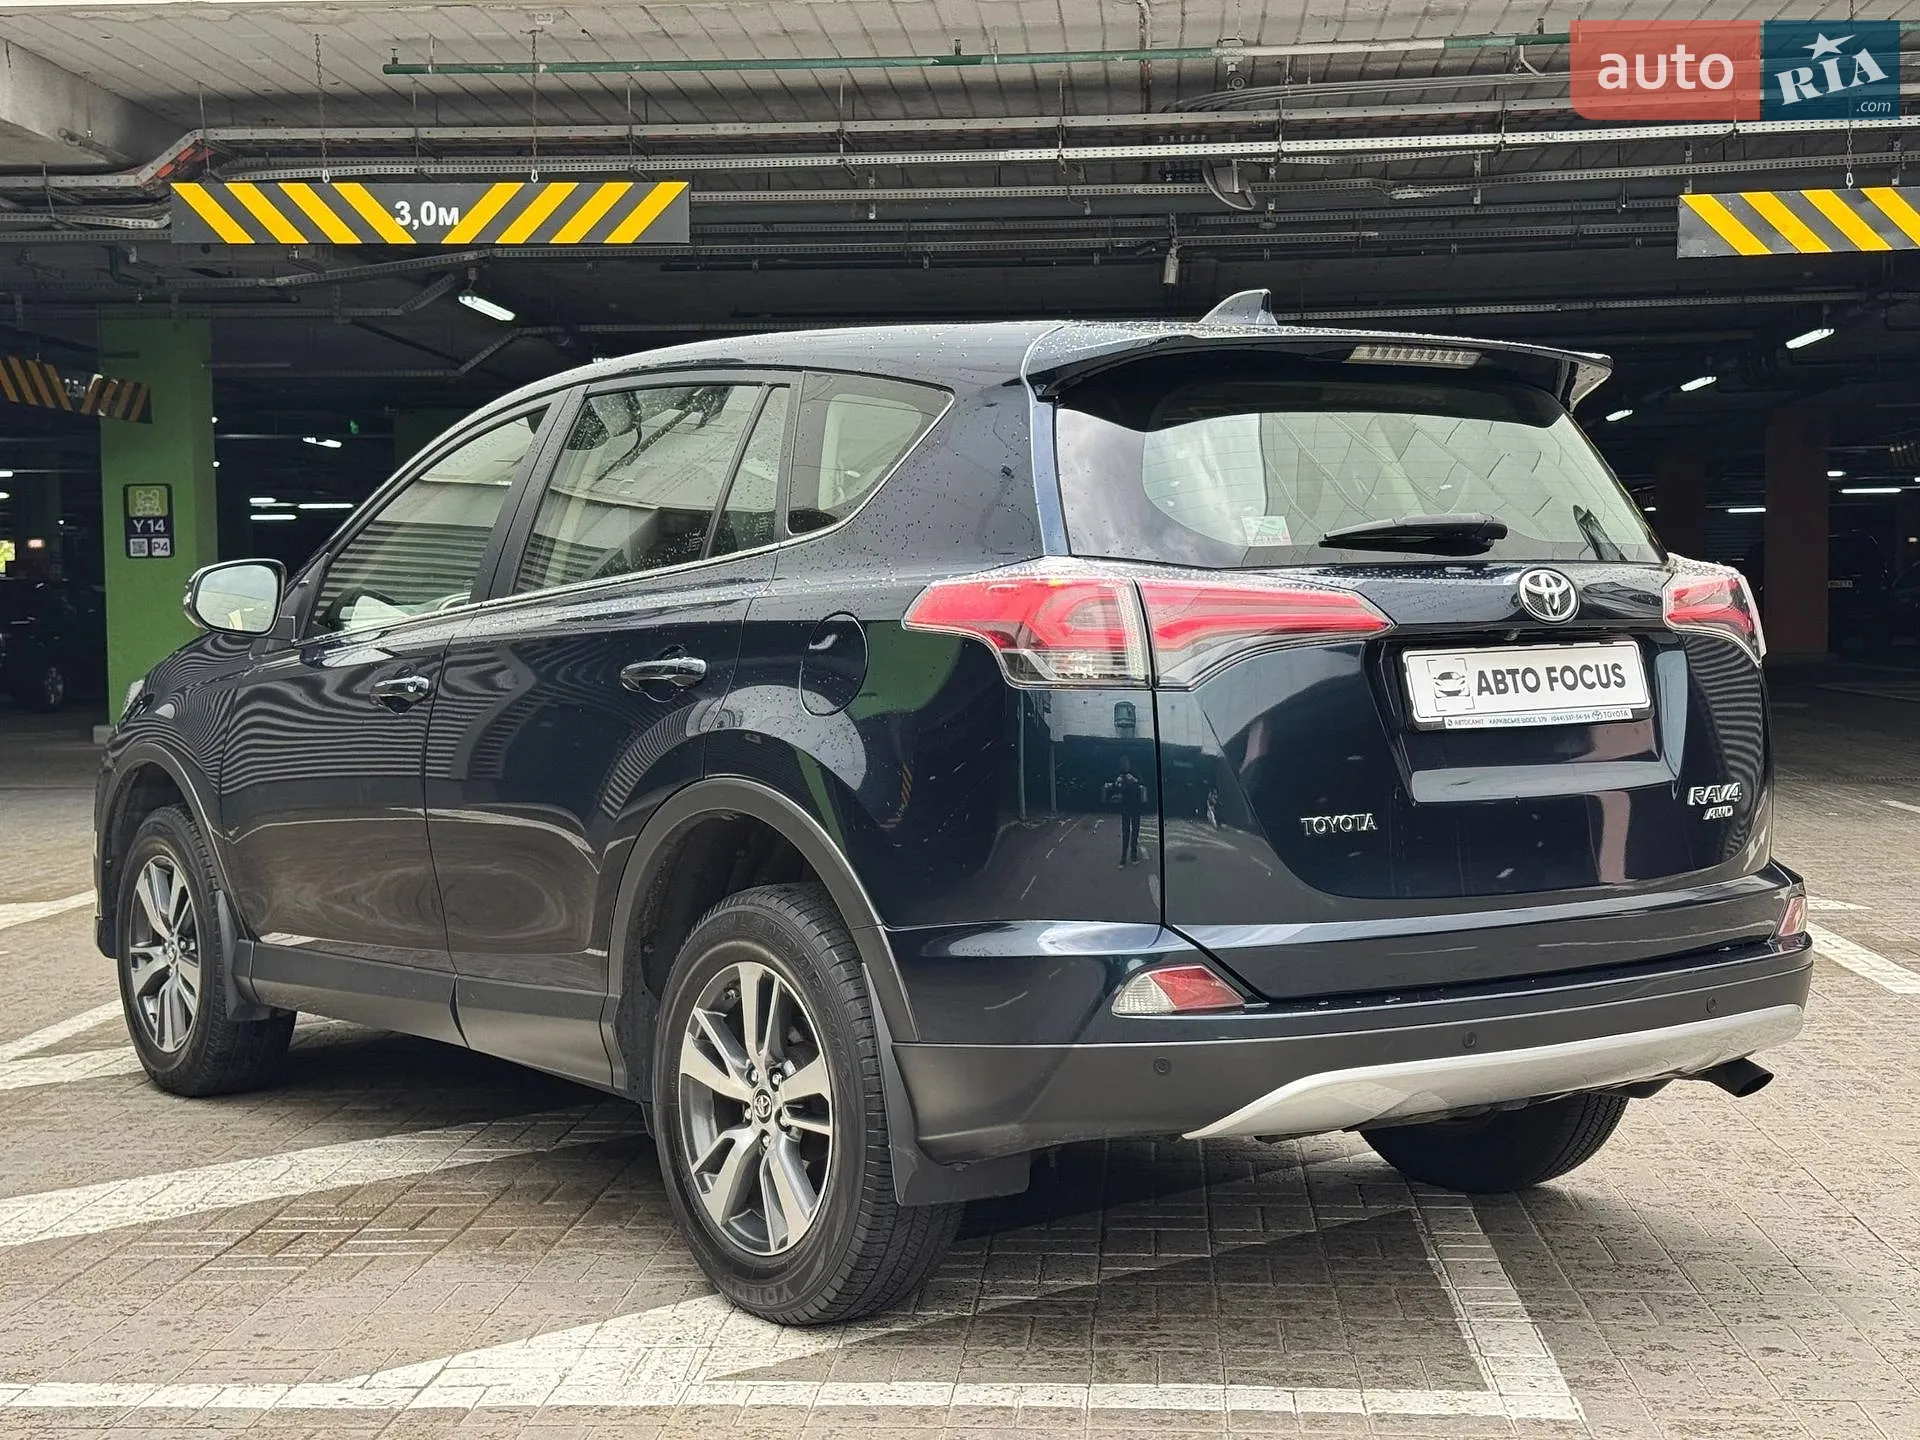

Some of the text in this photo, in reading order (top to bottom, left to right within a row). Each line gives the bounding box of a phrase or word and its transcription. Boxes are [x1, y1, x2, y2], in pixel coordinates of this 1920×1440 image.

[394, 200, 460, 231] 3,0м
[152, 542, 168, 553] P4
[1476, 663, 1627, 696] АВТО FOCUS
[1603, 709, 1629, 718] TOYOTA
[1687, 782, 1742, 805] RAV4
[1703, 805, 1734, 820] AWD
[1300, 813, 1379, 836] TOYOTA
